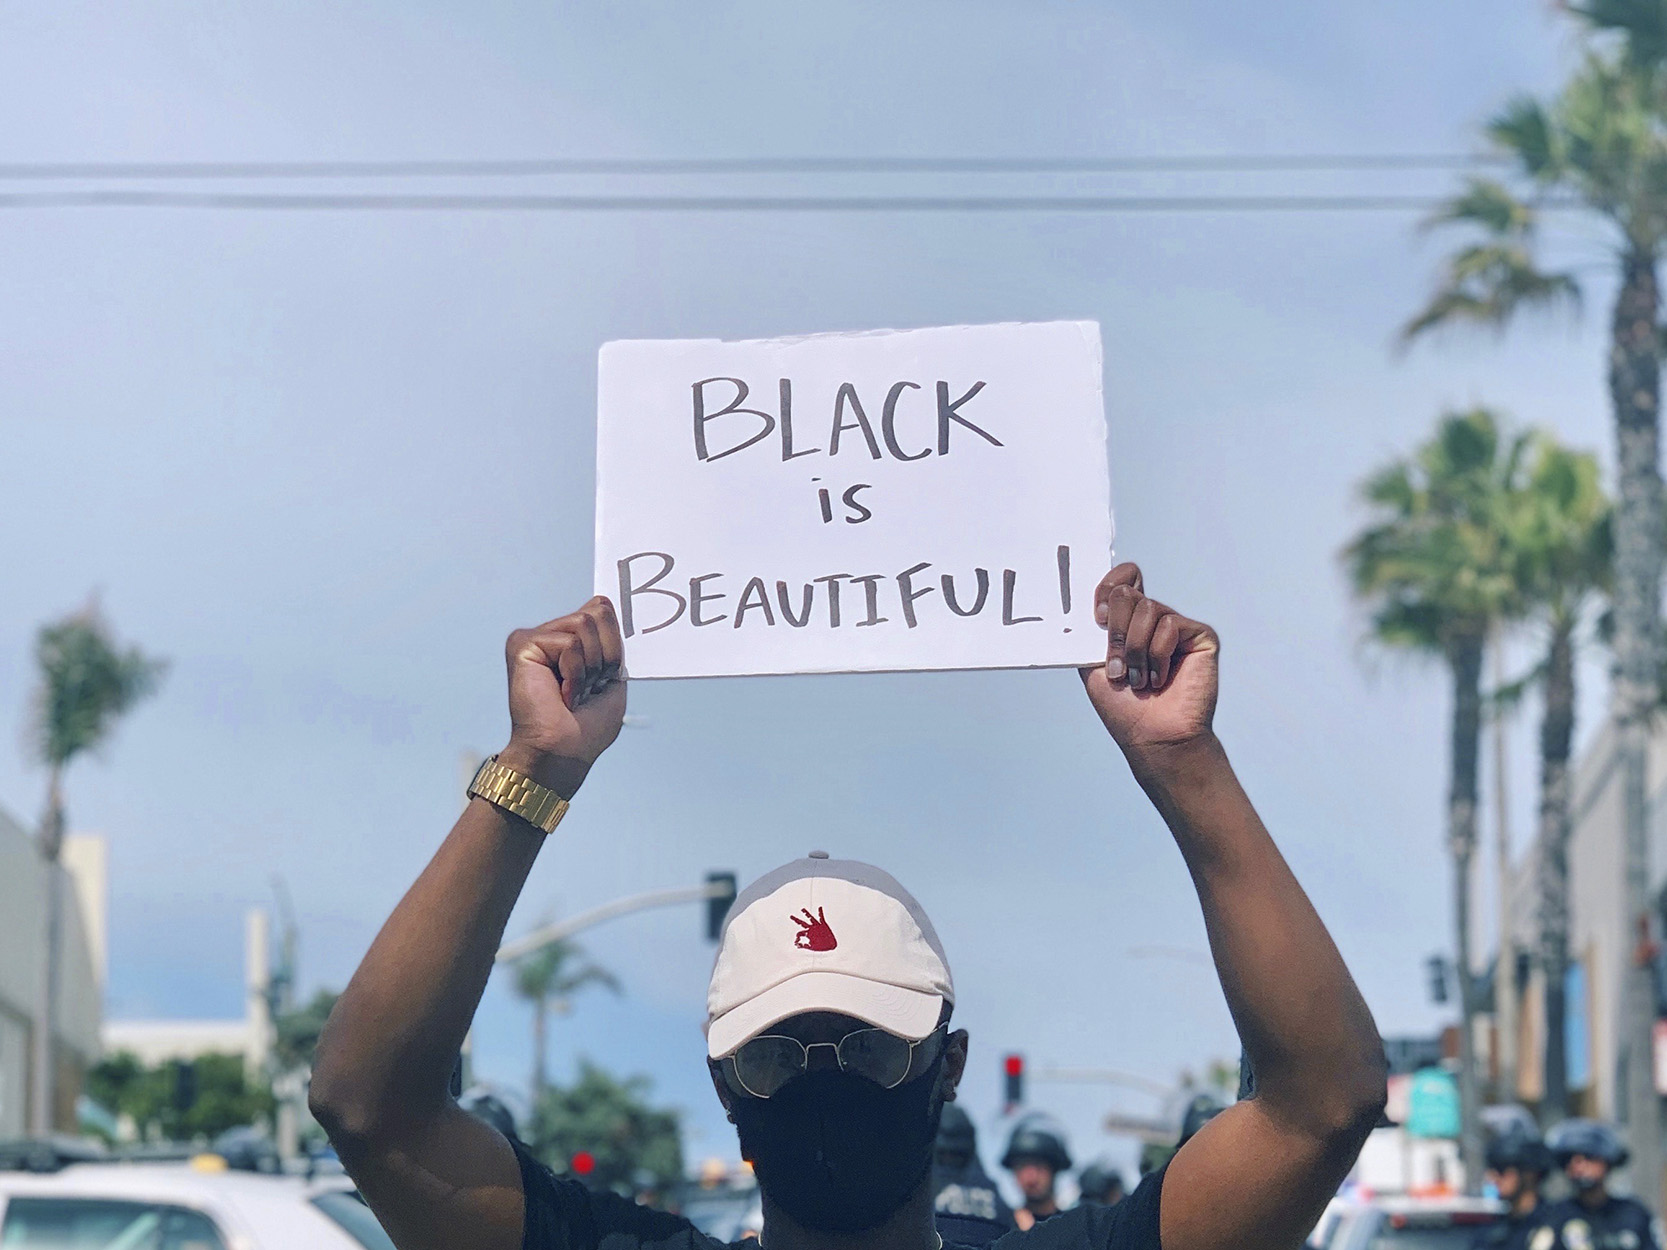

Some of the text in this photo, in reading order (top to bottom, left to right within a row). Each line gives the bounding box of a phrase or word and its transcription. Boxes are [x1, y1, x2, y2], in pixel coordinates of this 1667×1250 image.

[691, 377, 1004, 463] BLACK
[811, 477, 873, 524] is
[616, 544, 1073, 639] BEAUTIFUL!
